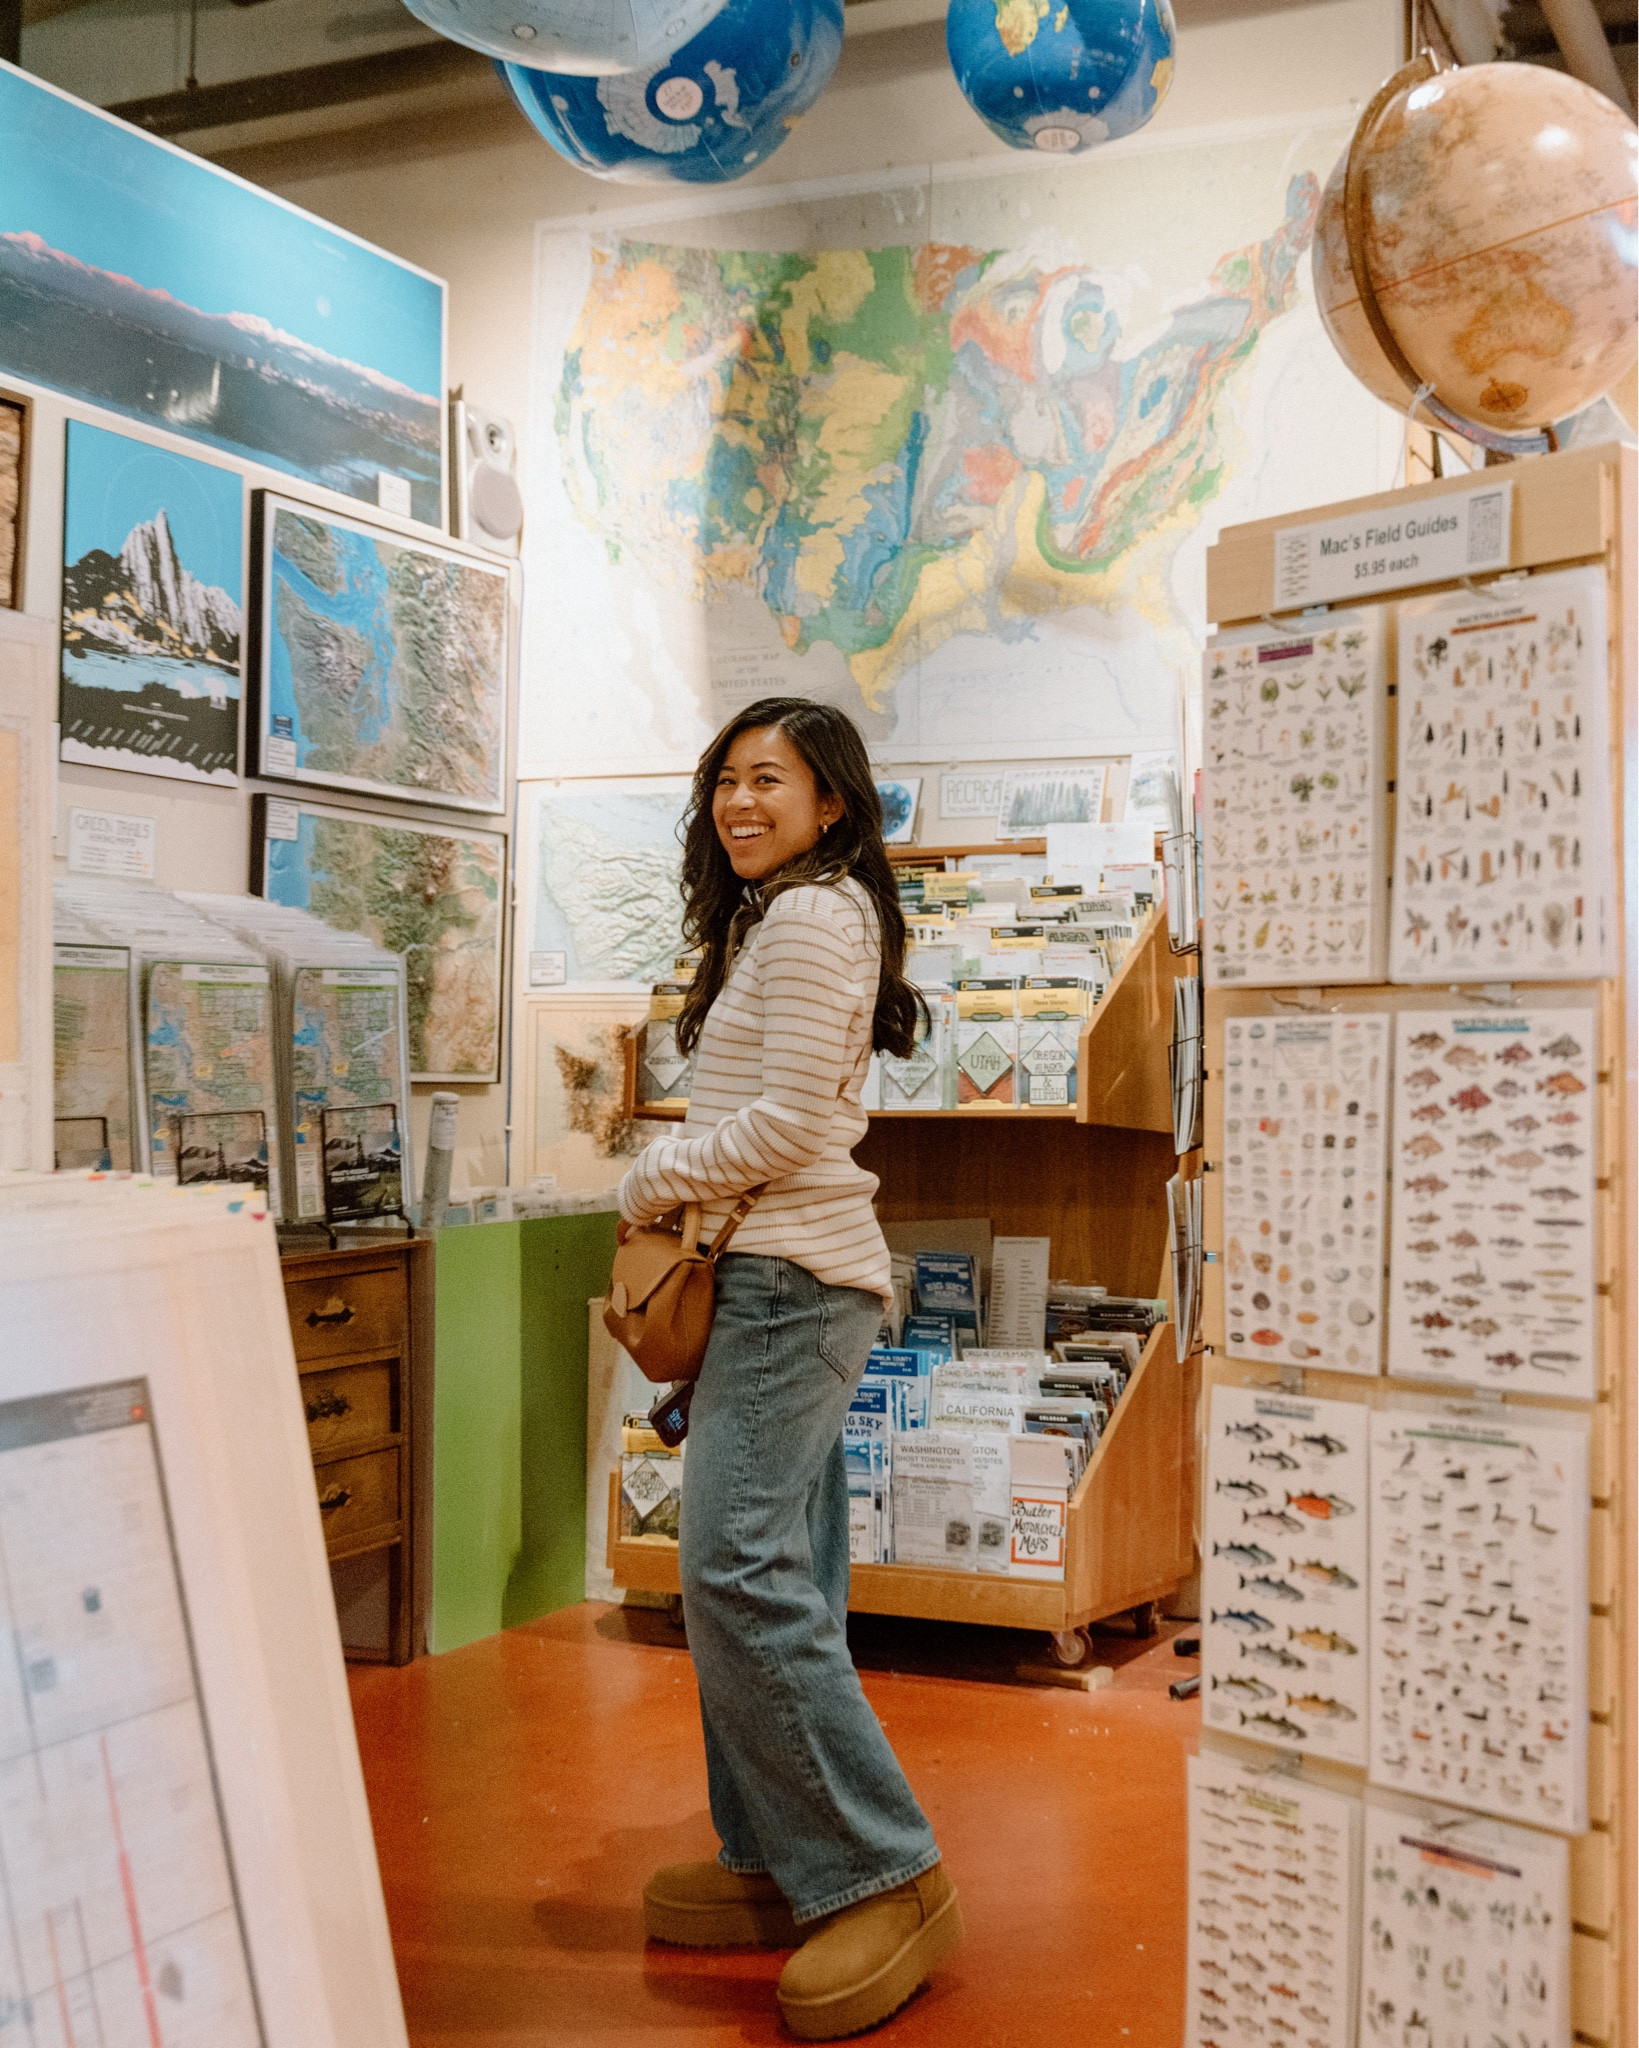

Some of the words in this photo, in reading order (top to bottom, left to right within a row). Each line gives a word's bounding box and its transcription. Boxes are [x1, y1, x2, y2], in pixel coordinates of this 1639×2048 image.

[1320, 534, 1361, 556] Mac's
[1365, 528, 1400, 548] Field
[1405, 515, 1458, 539] Guides
[1354, 558, 1386, 579] $5.95
[1389, 553, 1420, 572] each
[711, 679, 748, 689] UNITED
[751, 676, 786, 687] STATES
[77, 815, 113, 832] GREEN
[117, 820, 150, 838] TRAILS
[1048, 932, 1090, 942] ALASKA
[1032, 1050, 1066, 1061] OREGON
[970, 1054, 1000, 1071] UTAH
[1035, 1063, 1064, 1074] ALASKA
[1043, 1077, 1052, 1088] &
[1031, 1088, 1066, 1101] IDAHO
[892, 1354, 912, 1362] COUNTY
[946, 1404, 1015, 1417] CALIFORNIA
[859, 1415, 883, 1431] SKY
[846, 1428, 872, 1437] MAPS
[900, 1445, 960, 1456] WASHINGTON
[922, 1457, 966, 1465] TOWNS/SITES
[1012, 1500, 1055, 1518] Butler
[1012, 1519, 1063, 1537] MOTORCYCLE
[1019, 1536, 1049, 1555] MAPS
